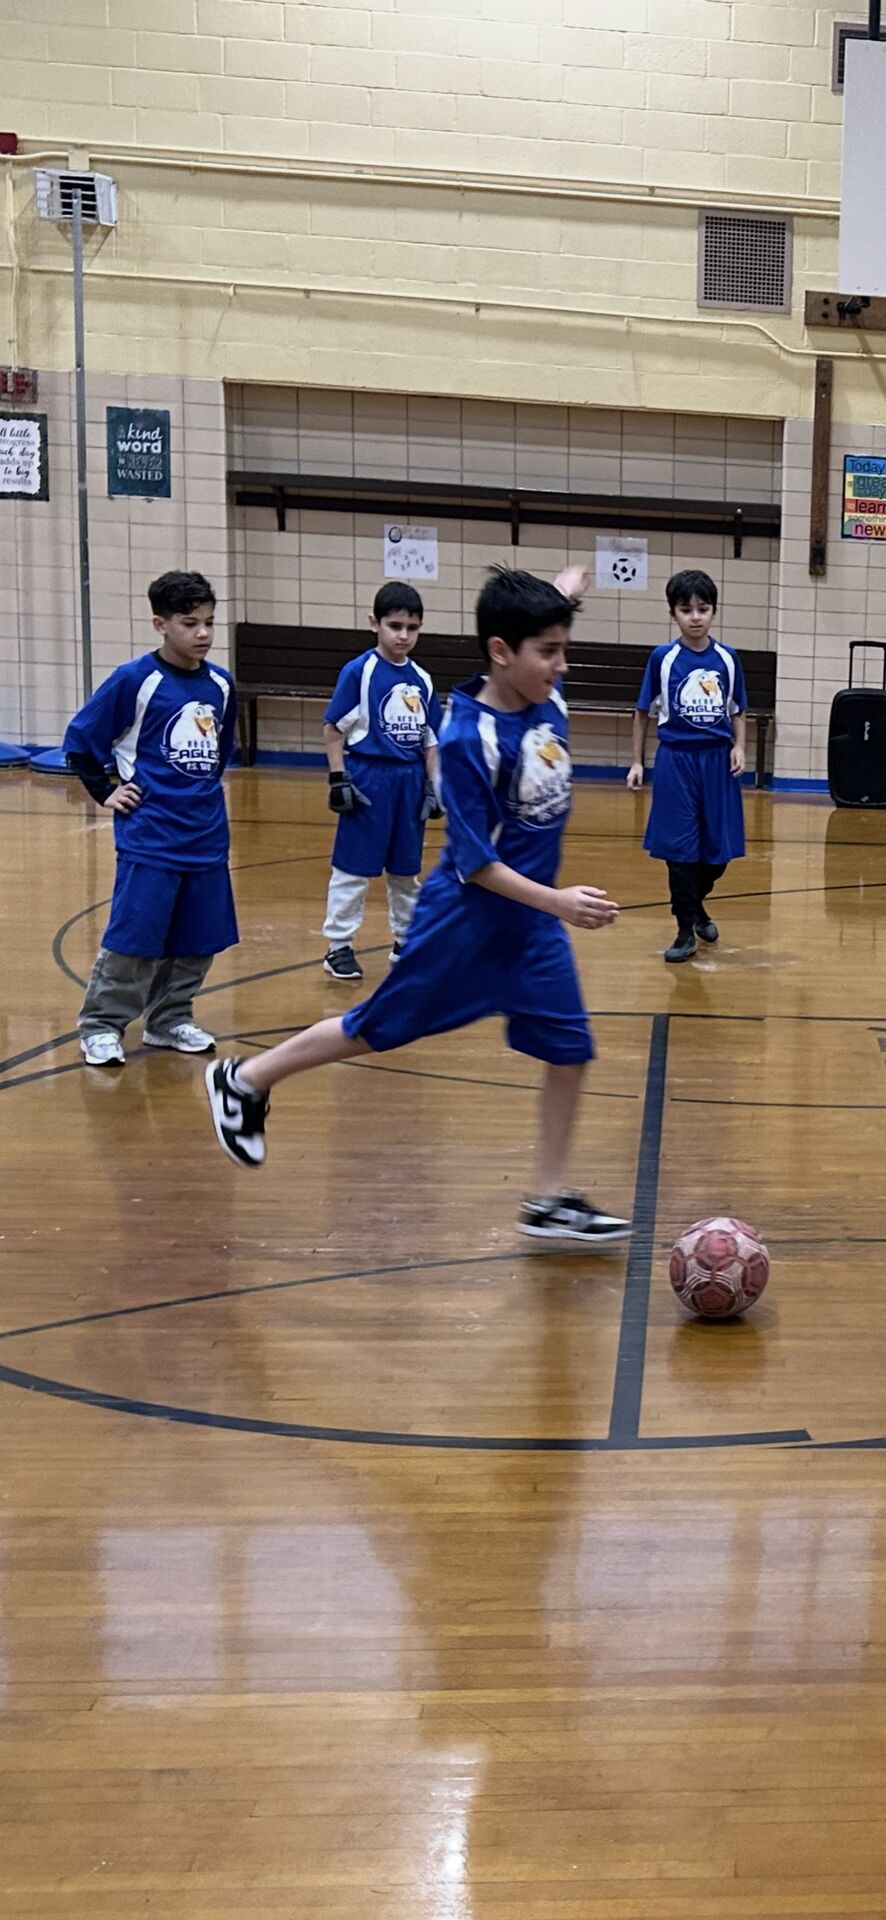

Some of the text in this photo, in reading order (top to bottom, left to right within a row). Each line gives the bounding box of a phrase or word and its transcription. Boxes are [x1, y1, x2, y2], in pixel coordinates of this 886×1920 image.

[9, 427, 31, 438] little
[127, 422, 163, 440] kind
[0, 447, 35, 459] ach day
[116, 440, 162, 454] word
[22, 460, 34, 469] up
[848, 459, 885, 475] Today
[4, 465, 30, 478] to big
[116, 468, 163, 481] WASTED
[856, 476, 886, 490] grea
[854, 523, 886, 536] new
